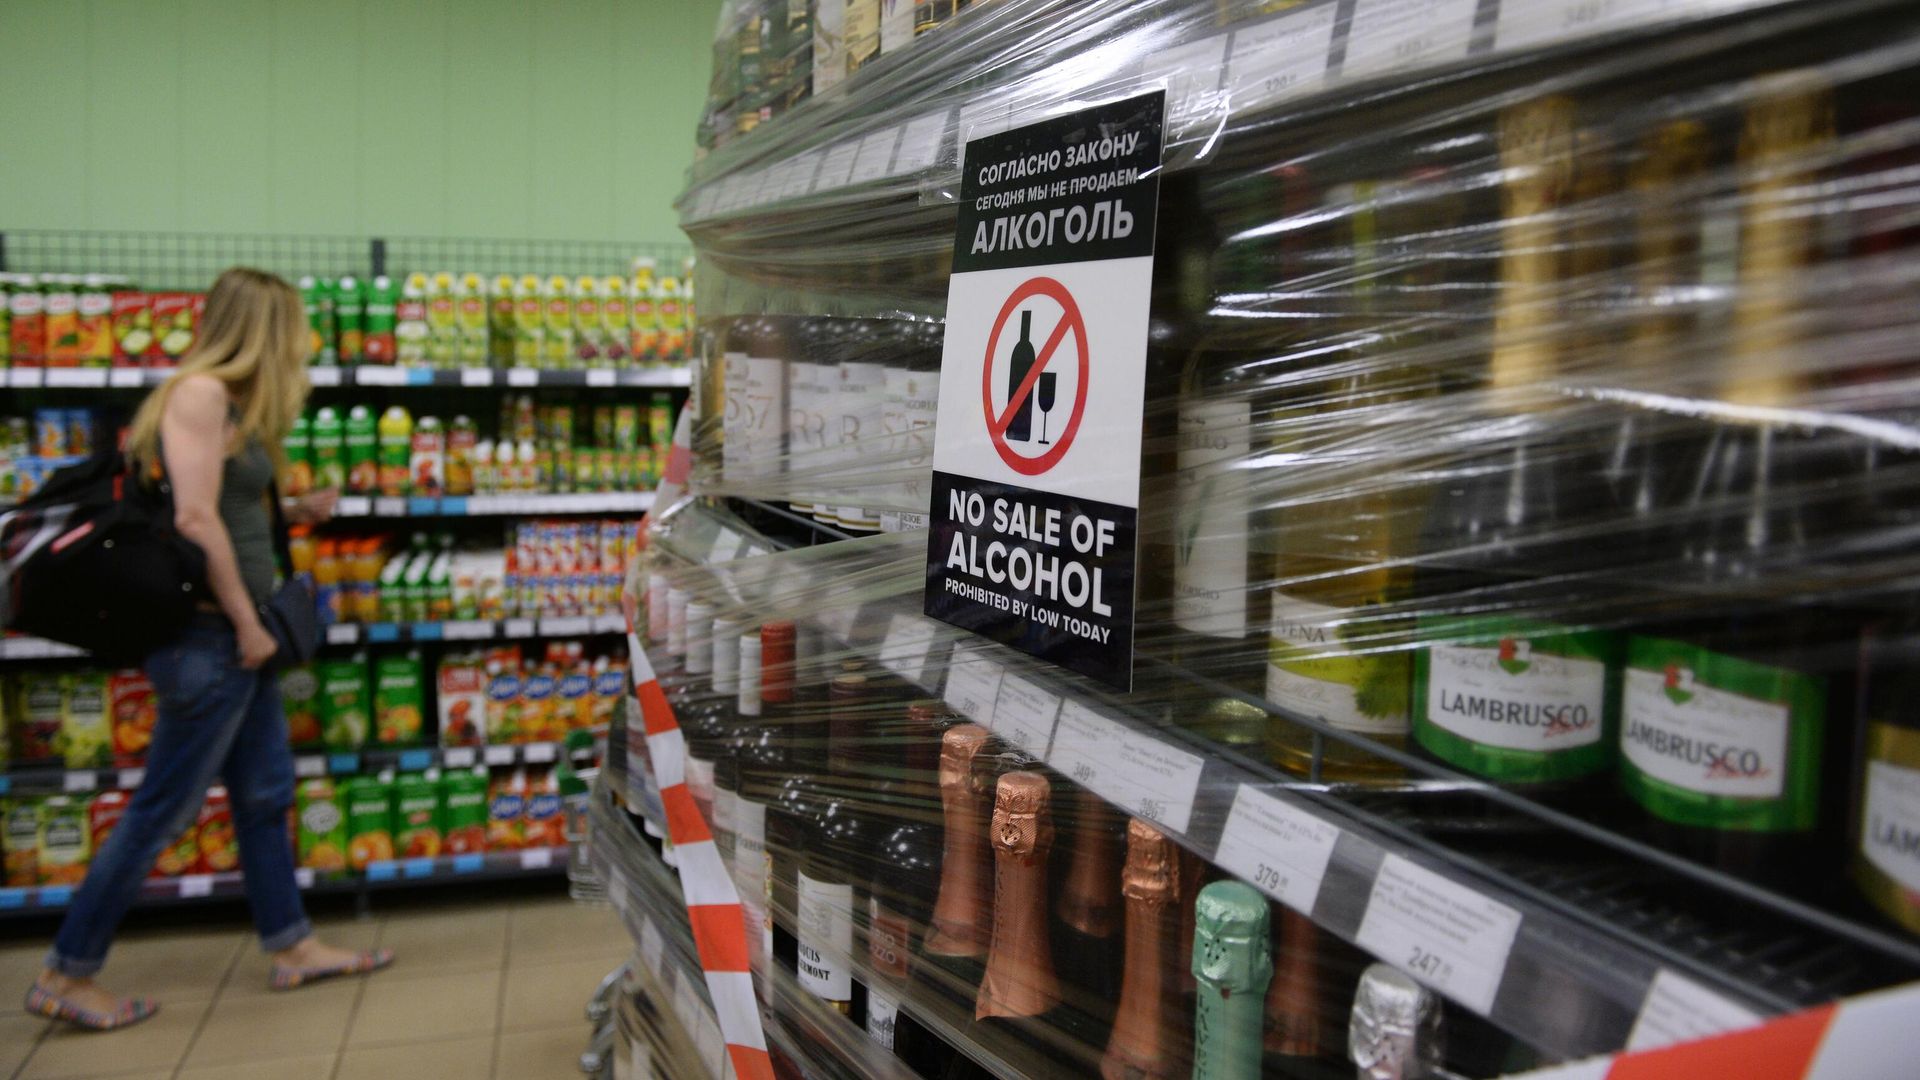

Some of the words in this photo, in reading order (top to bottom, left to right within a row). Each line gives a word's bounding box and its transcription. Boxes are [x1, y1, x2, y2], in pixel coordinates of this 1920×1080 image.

[979, 149, 1061, 186] СОГЛАСНО
[1064, 131, 1140, 167] ЗАКОНУ
[976, 191, 1025, 211] СЕГОДНЯ
[1027, 184, 1048, 200] МЫ
[1050, 181, 1066, 198] НЕ
[1070, 167, 1138, 193] ПРОДАЕМ
[971, 199, 1134, 255] АЛКОГОЛЬ
[949, 488, 985, 527] NO
[992, 498, 1061, 547] SALE
[1070, 514, 1115, 557] OF
[946, 531, 1112, 617] ALCOHOL
[945, 577, 1010, 611] PROHIBITED
[1012, 596, 1029, 617] BY
[1031, 605, 1060, 626] LOW
[1063, 615, 1111, 645] TODAY
[1440, 689, 1589, 728] LAMBRUSCO
[1255, 863, 1280, 890] 379
[1408, 946, 1441, 977] 247
